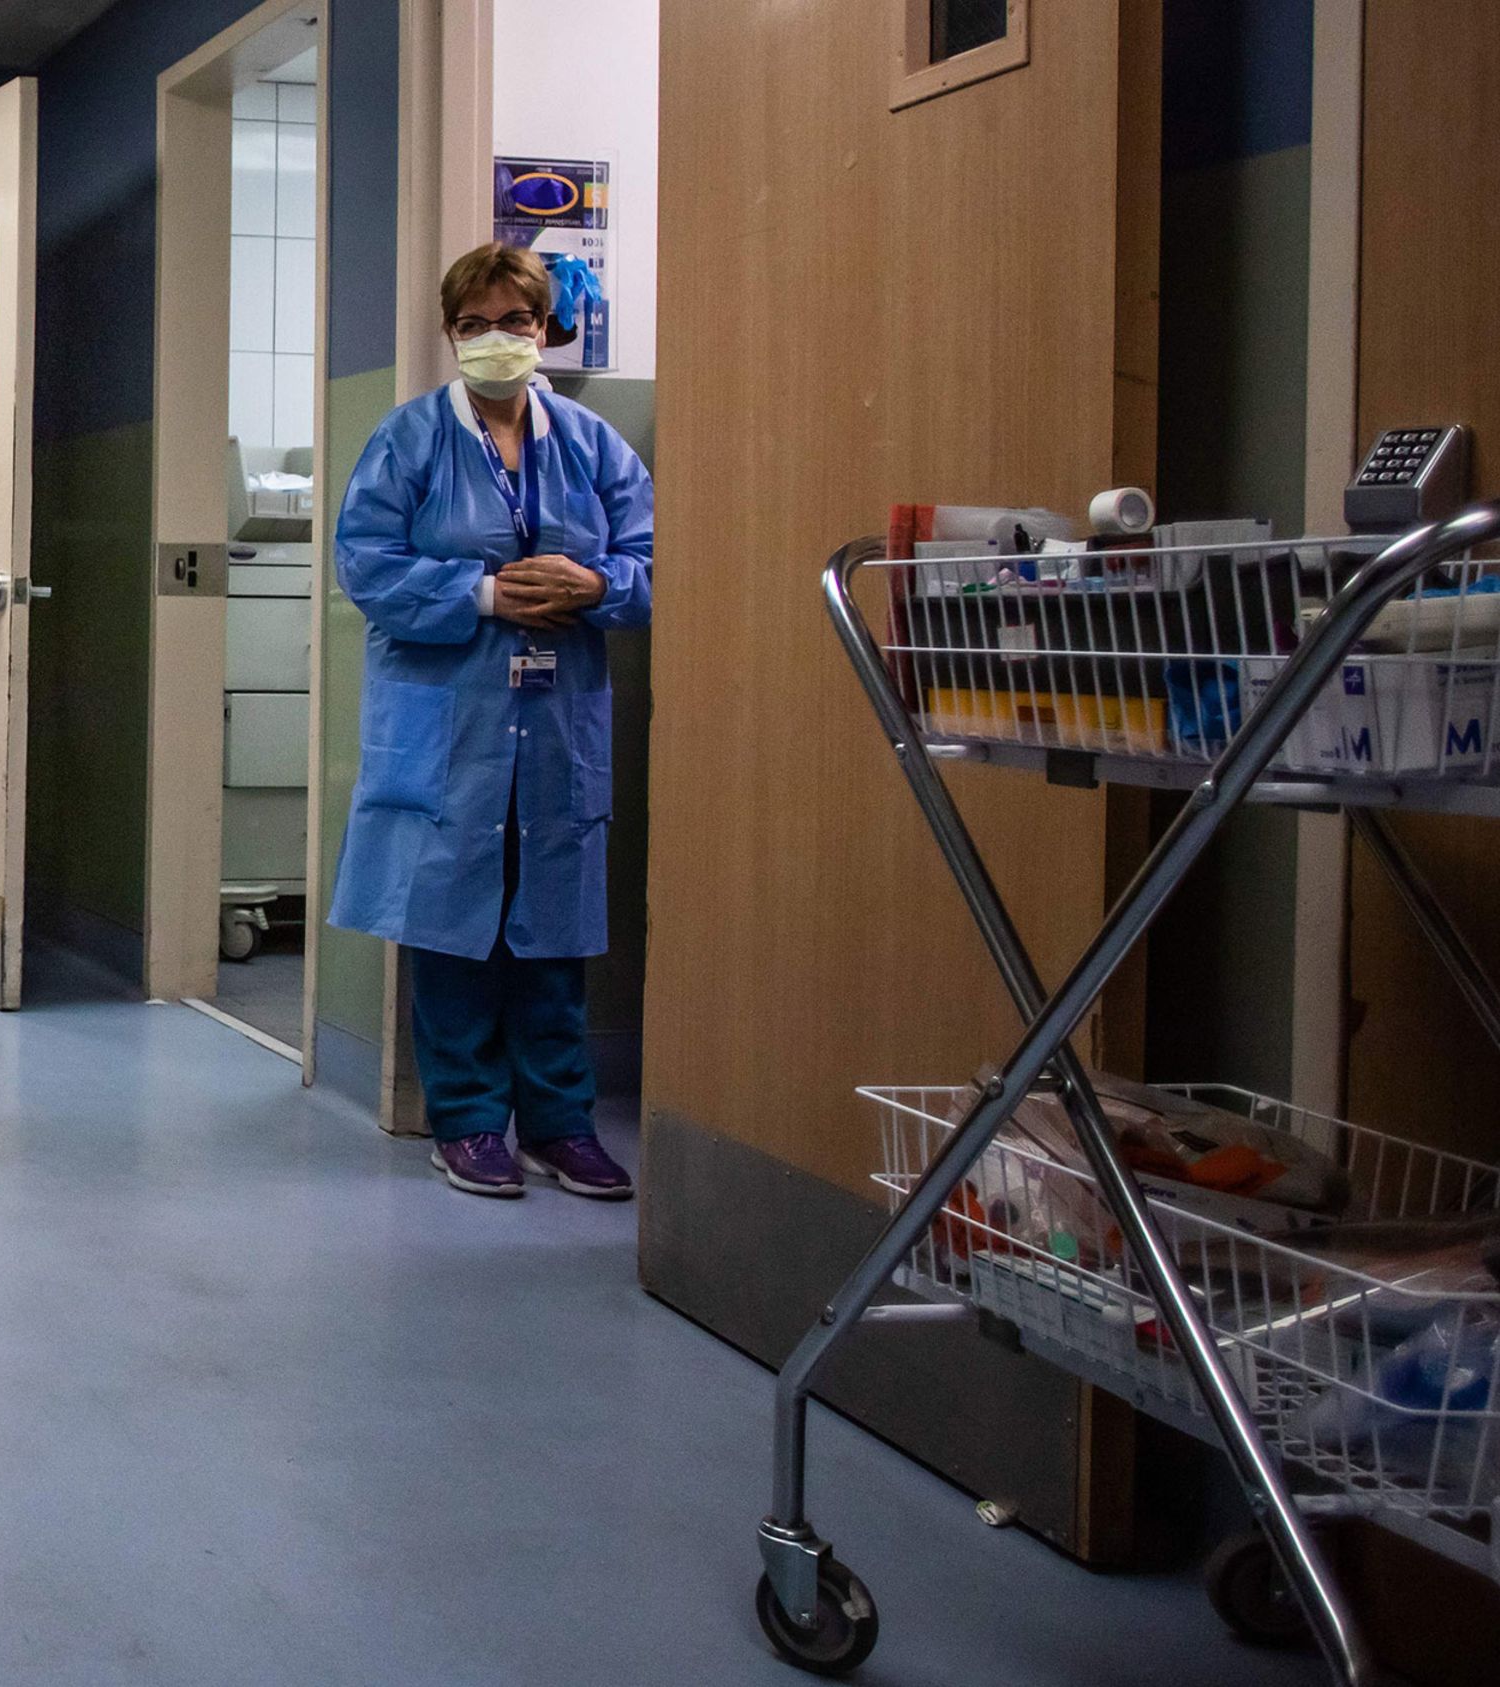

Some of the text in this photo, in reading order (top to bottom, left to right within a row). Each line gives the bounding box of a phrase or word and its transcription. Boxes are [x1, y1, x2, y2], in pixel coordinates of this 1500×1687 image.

[591, 312, 603, 326] M
[1341, 726, 1372, 762] M
[1444, 718, 1481, 755] M
